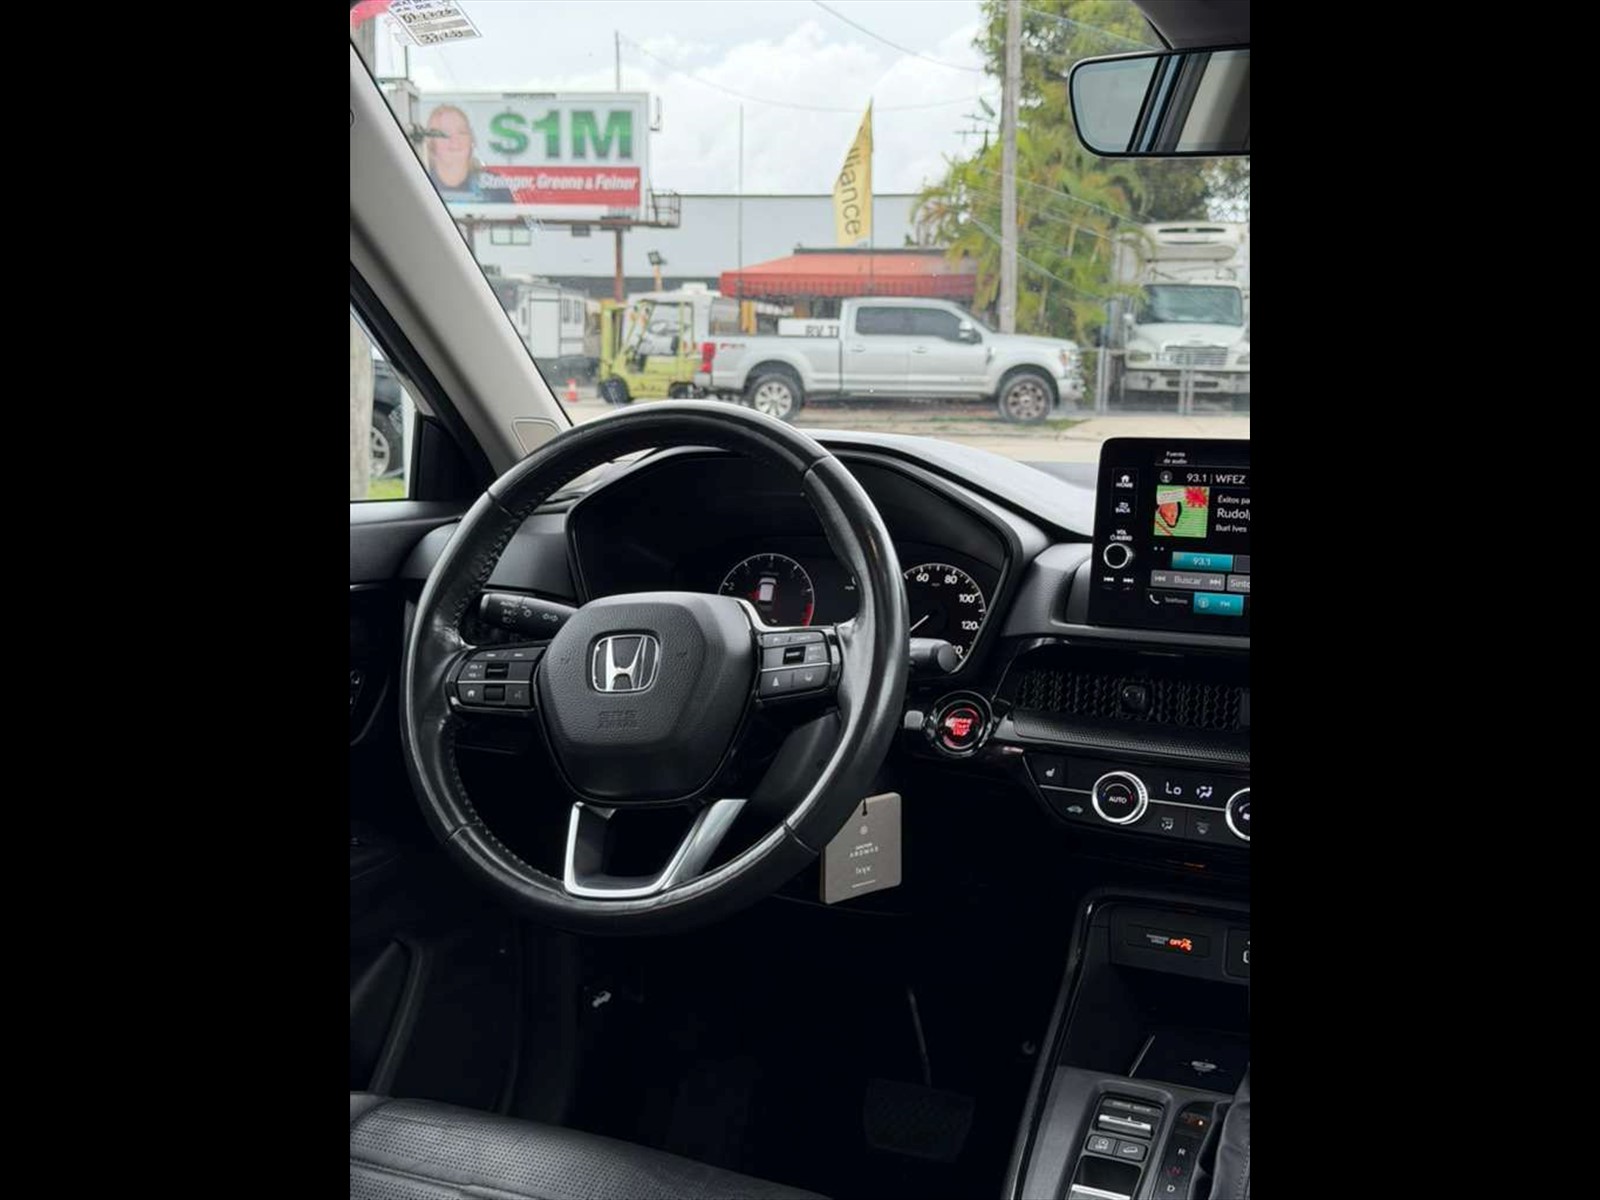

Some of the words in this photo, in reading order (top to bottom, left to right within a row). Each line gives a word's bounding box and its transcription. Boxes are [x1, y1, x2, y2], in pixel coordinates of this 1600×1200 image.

[488, 107, 634, 162] $1M
[536, 172, 584, 190] Greene
[594, 174, 638, 190] Feiner
[842, 145, 862, 236] lliance
[1186, 473, 1207, 483] 93.1
[1215, 474, 1246, 485] WFEZ
[1217, 494, 1239, 504] Éxitos
[1193, 557, 1211, 567] 93.1
[916, 573, 929, 582] 60
[944, 574, 958, 584] 80
[1174, 575, 1202, 586] Buscar
[959, 593, 975, 604] 100
[961, 621, 979, 631] 120
[1165, 782, 1182, 796] Lo
[1108, 796, 1128, 804] AUTO
